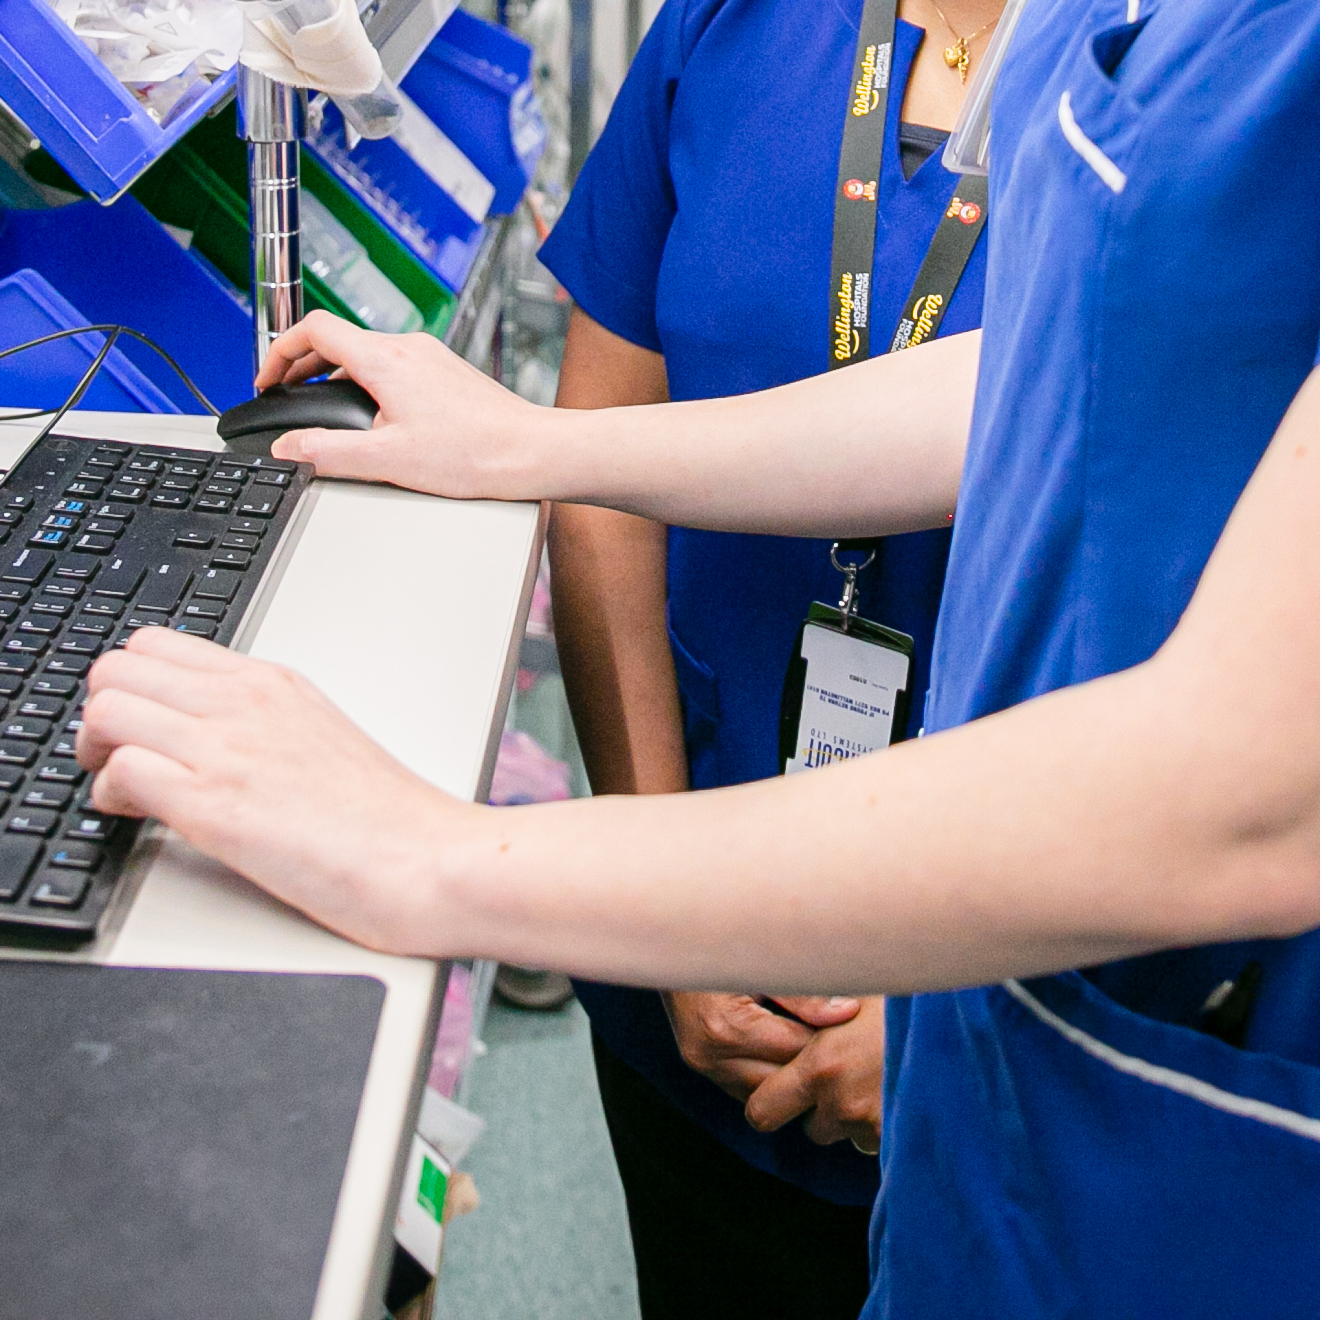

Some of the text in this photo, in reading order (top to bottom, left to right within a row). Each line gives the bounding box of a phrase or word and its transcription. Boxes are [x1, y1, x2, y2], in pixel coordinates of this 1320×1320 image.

[852, 44, 877, 117] Wellington
[874, 43, 885, 89] HOSPITALS
[880, 42, 892, 89] FOUNDATION
[834, 271, 853, 361] Wellington
[853, 273, 863, 328] HOSPITALS
[860, 273, 870, 328] FOUNDATION
[896, 320, 914, 351] HOSP
[112, 553, 123, 570] Enter
[821, 688, 853, 703] WELLINGTON
[828, 698, 848, 709] RETURN
[850, 705, 868, 717] FOUND
[810, 727, 827, 737] LTD
